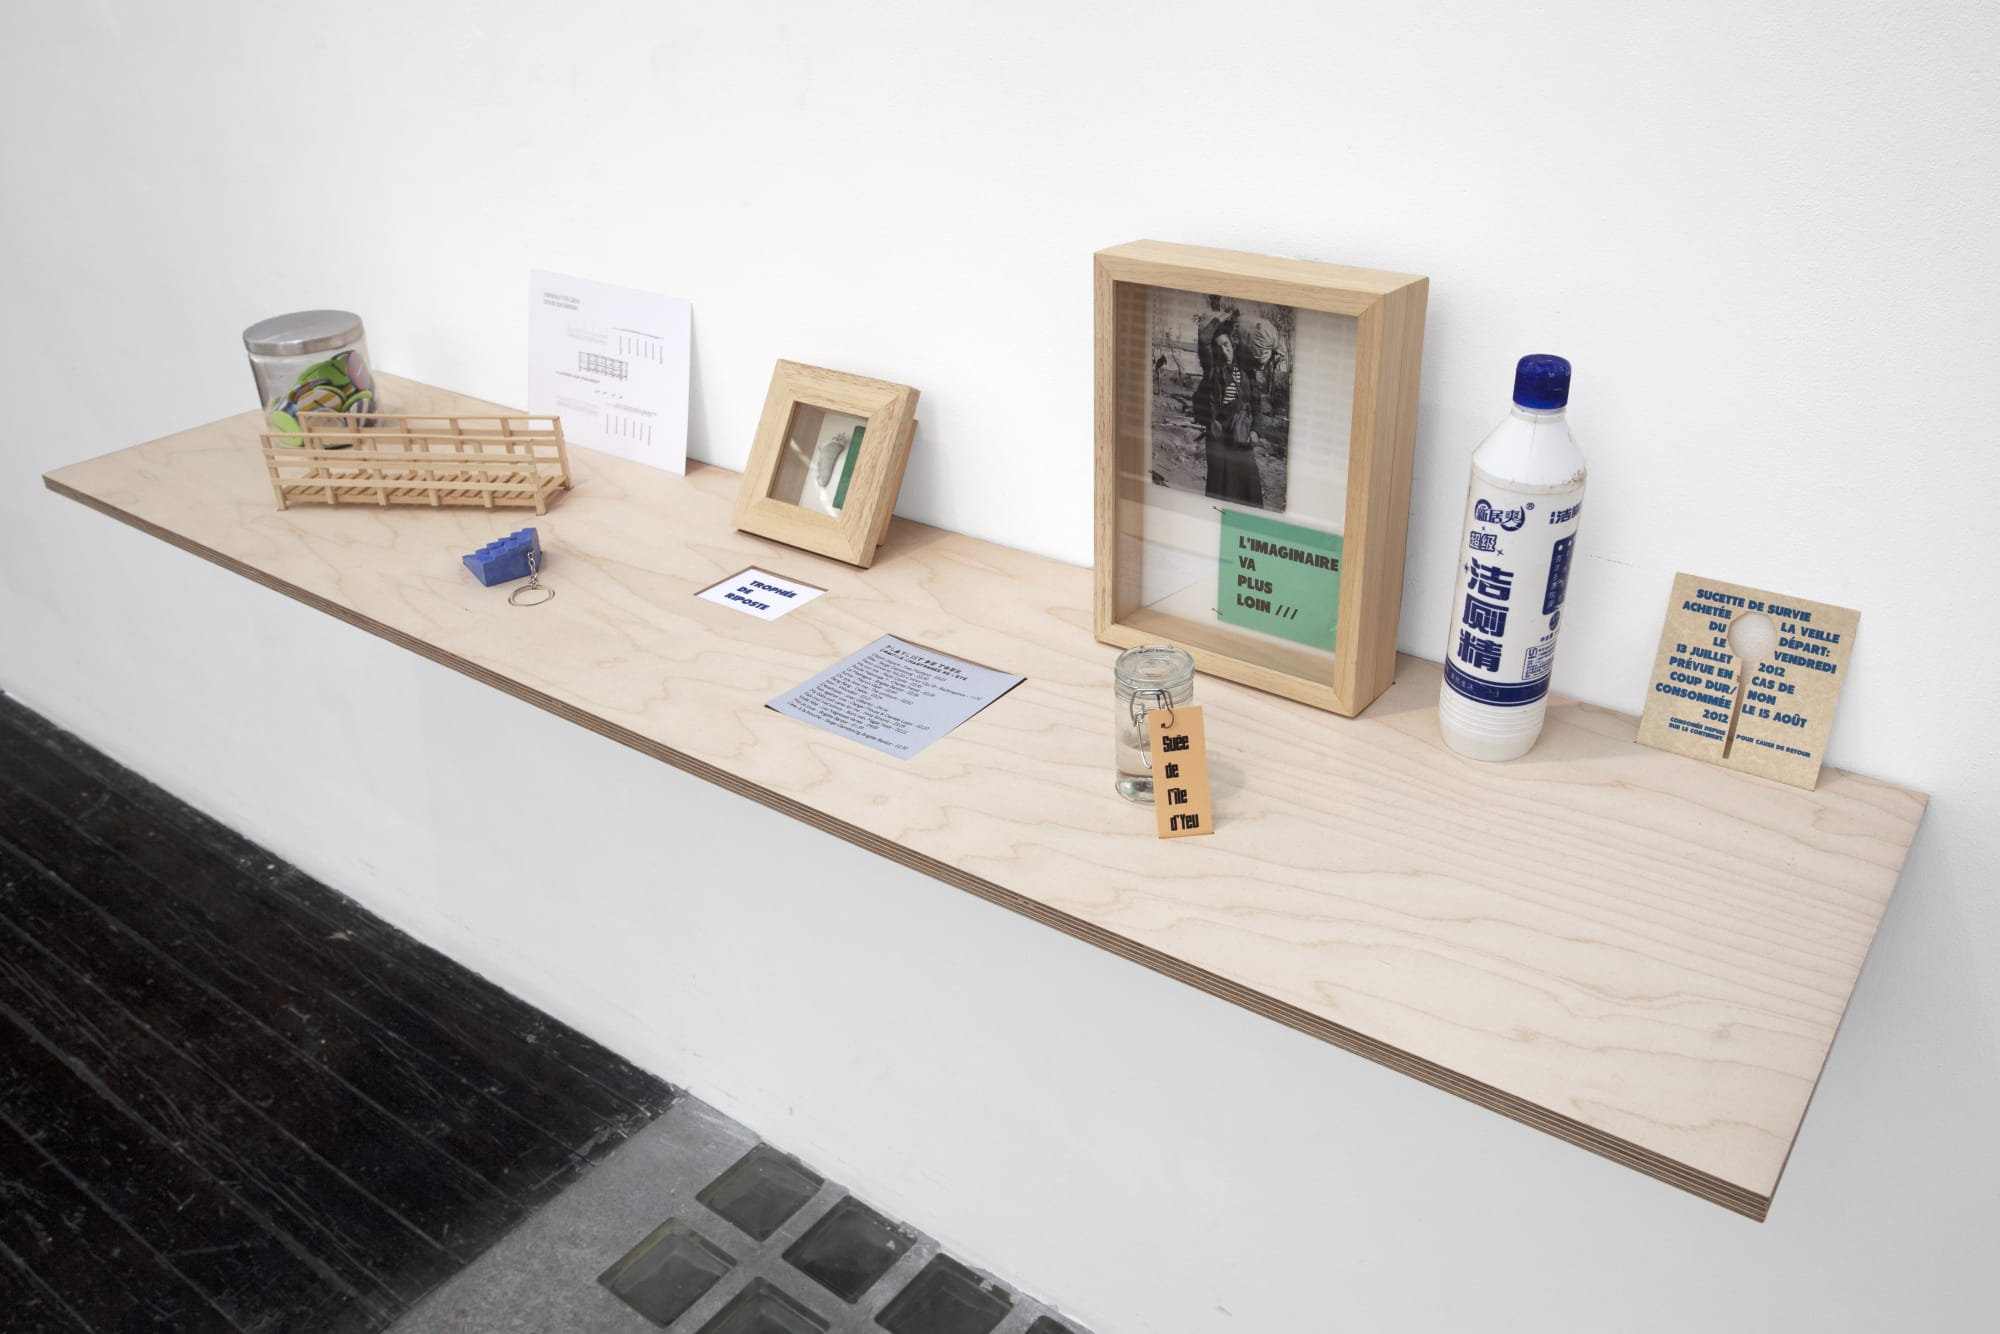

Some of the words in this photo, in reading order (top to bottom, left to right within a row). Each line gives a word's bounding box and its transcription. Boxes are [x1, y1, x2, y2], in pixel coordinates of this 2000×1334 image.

[1239, 536, 1339, 572] L'IMAGINAIRE
[1239, 555, 1256, 571] VA
[736, 586, 754, 595] DE
[750, 580, 798, 599] TROPHÉE
[1237, 574, 1273, 594] PLUS
[724, 592, 771, 610] RIPOSTE
[1236, 593, 1271, 614] LOIN
[1696, 588, 1746, 608] SUCETTE
[1748, 600, 1764, 612] DE
[1767, 604, 1812, 622] SURVIE
[1457, 556, 1514, 672] 洁厕精
[1682, 600, 1733, 620] ACHETÉE
[1780, 622, 1796, 635] LA
[1800, 626, 1840, 644] VEILLE
[1708, 621, 1727, 633] DU
[1778, 636, 1831, 657] DÉPART:
[1676, 643, 1687, 654] 13
[1689, 646, 1734, 665] JUILLET
[1758, 662, 1786, 677] 2012
[1712, 636, 1727, 648] LE
[1774, 650, 1837, 674] VENDREDI
[1669, 656, 1715, 675] PRÉVUE
[1717, 667, 1734, 680] EN
[1751, 676, 1775, 690] CAS
[1777, 684, 1795, 695] DE
[1669, 671, 1703, 686] COUP
[1747, 690, 1777, 705] NON
[1655, 682, 1732, 709] CONSOMMÉE
[1741, 703, 1755, 716] LE
[1758, 707, 1770, 719] 15
[1773, 712, 1808, 728] AOÛT
[1702, 709, 1729, 724] 2012
[1162, 735, 1189, 752] Suée
[1736, 734, 1754, 743] POUR
[1755, 739, 1774, 748] CAUSE
[1776, 743, 1785, 751] DE
[1786, 746, 1811, 758] RETOUR
[1165, 762, 1179, 779] de
[1170, 813, 1200, 831] d'Yeu
